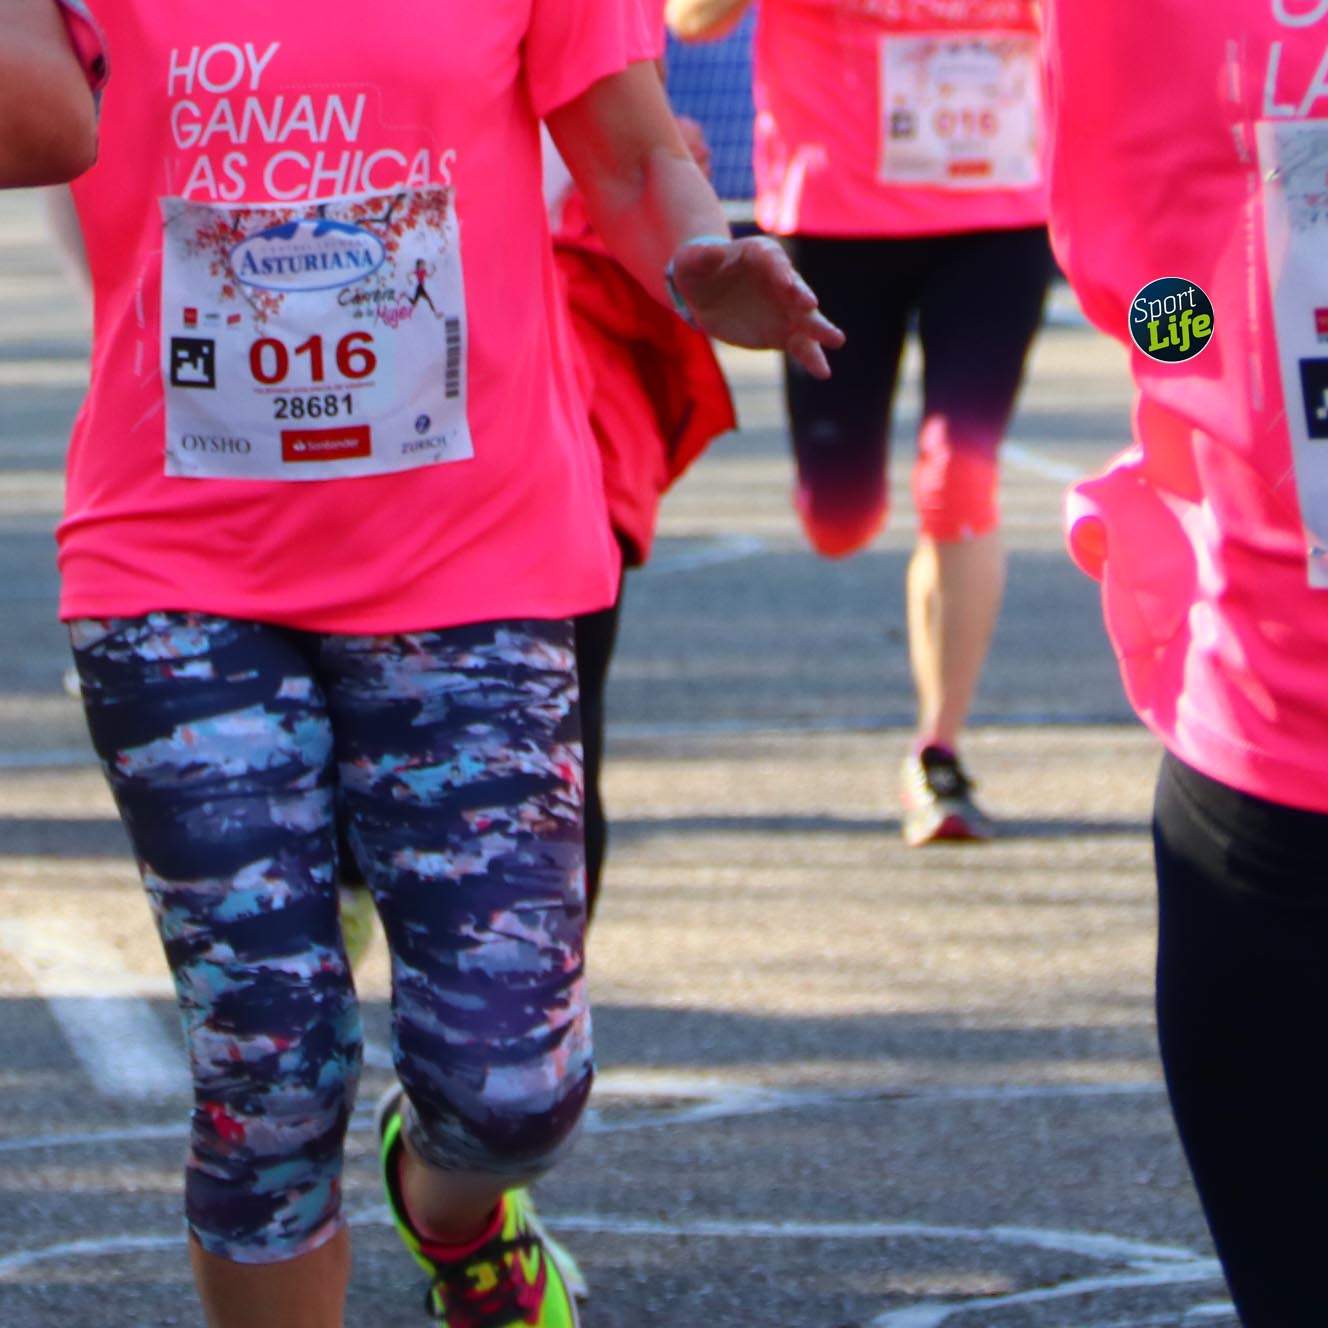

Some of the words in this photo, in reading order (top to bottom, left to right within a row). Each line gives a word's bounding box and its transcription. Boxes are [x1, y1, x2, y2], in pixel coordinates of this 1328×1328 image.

[168, 42, 281, 96] HOY
[171, 93, 367, 150] GANAN
[263, 148, 458, 200] CHICAS
[241, 249, 375, 275] ASTURIANA
[249, 331, 377, 385] 016
[274, 393, 353, 419] 28681
[182, 433, 252, 454] OYSHO
